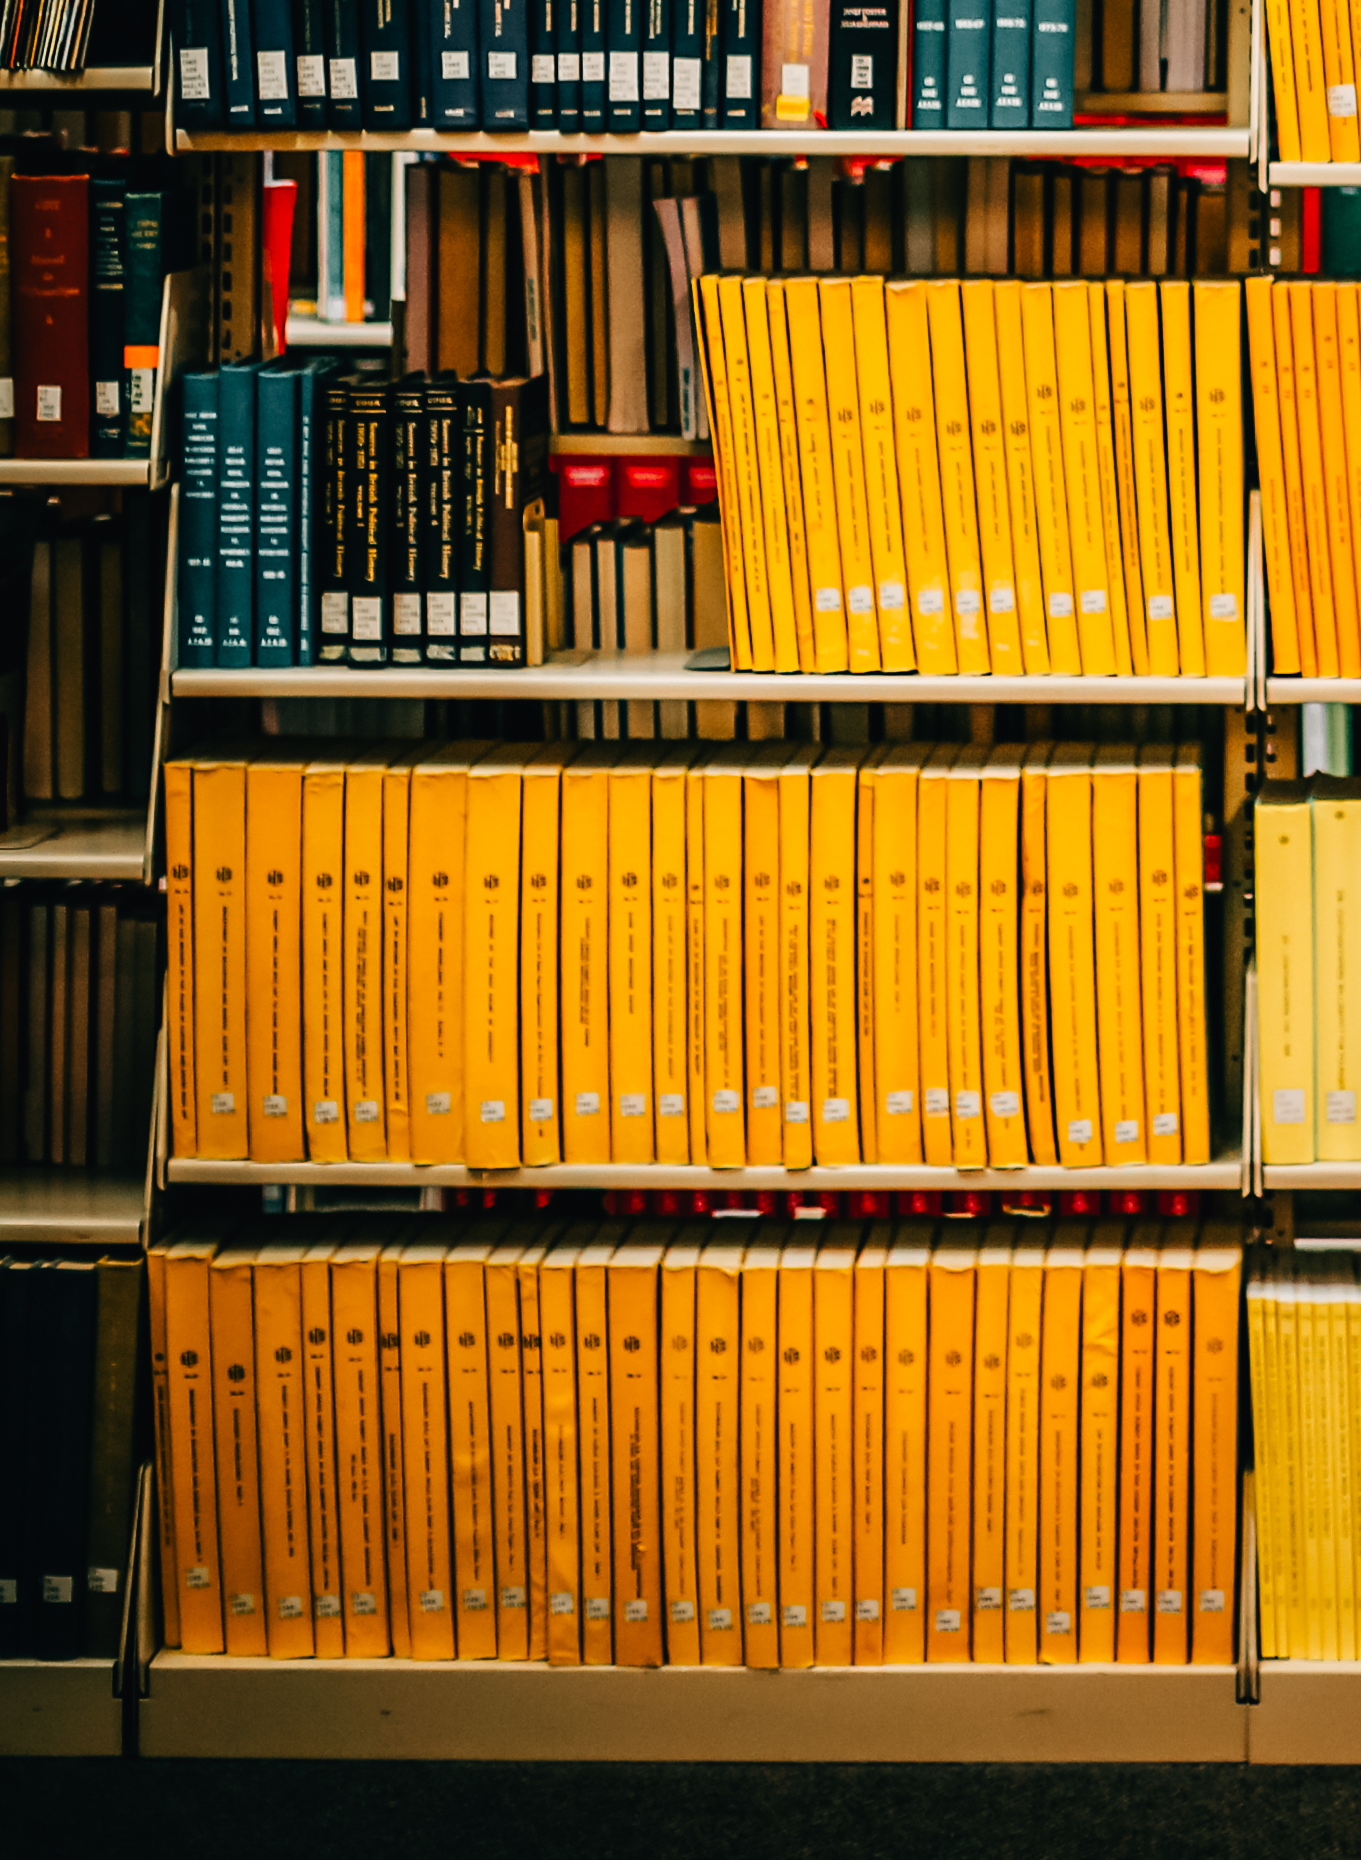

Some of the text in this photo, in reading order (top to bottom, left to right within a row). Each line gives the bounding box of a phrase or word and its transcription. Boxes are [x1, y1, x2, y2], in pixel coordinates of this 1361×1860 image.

[337, 470, 345, 500] British
[337, 504, 345, 541] Political
[365, 422, 378, 582] Sources in British Political History
[406, 422, 417, 582] Sources in British Political History
[439, 419, 452, 579] Sources in British Political History
[334, 545, 344, 578] History
